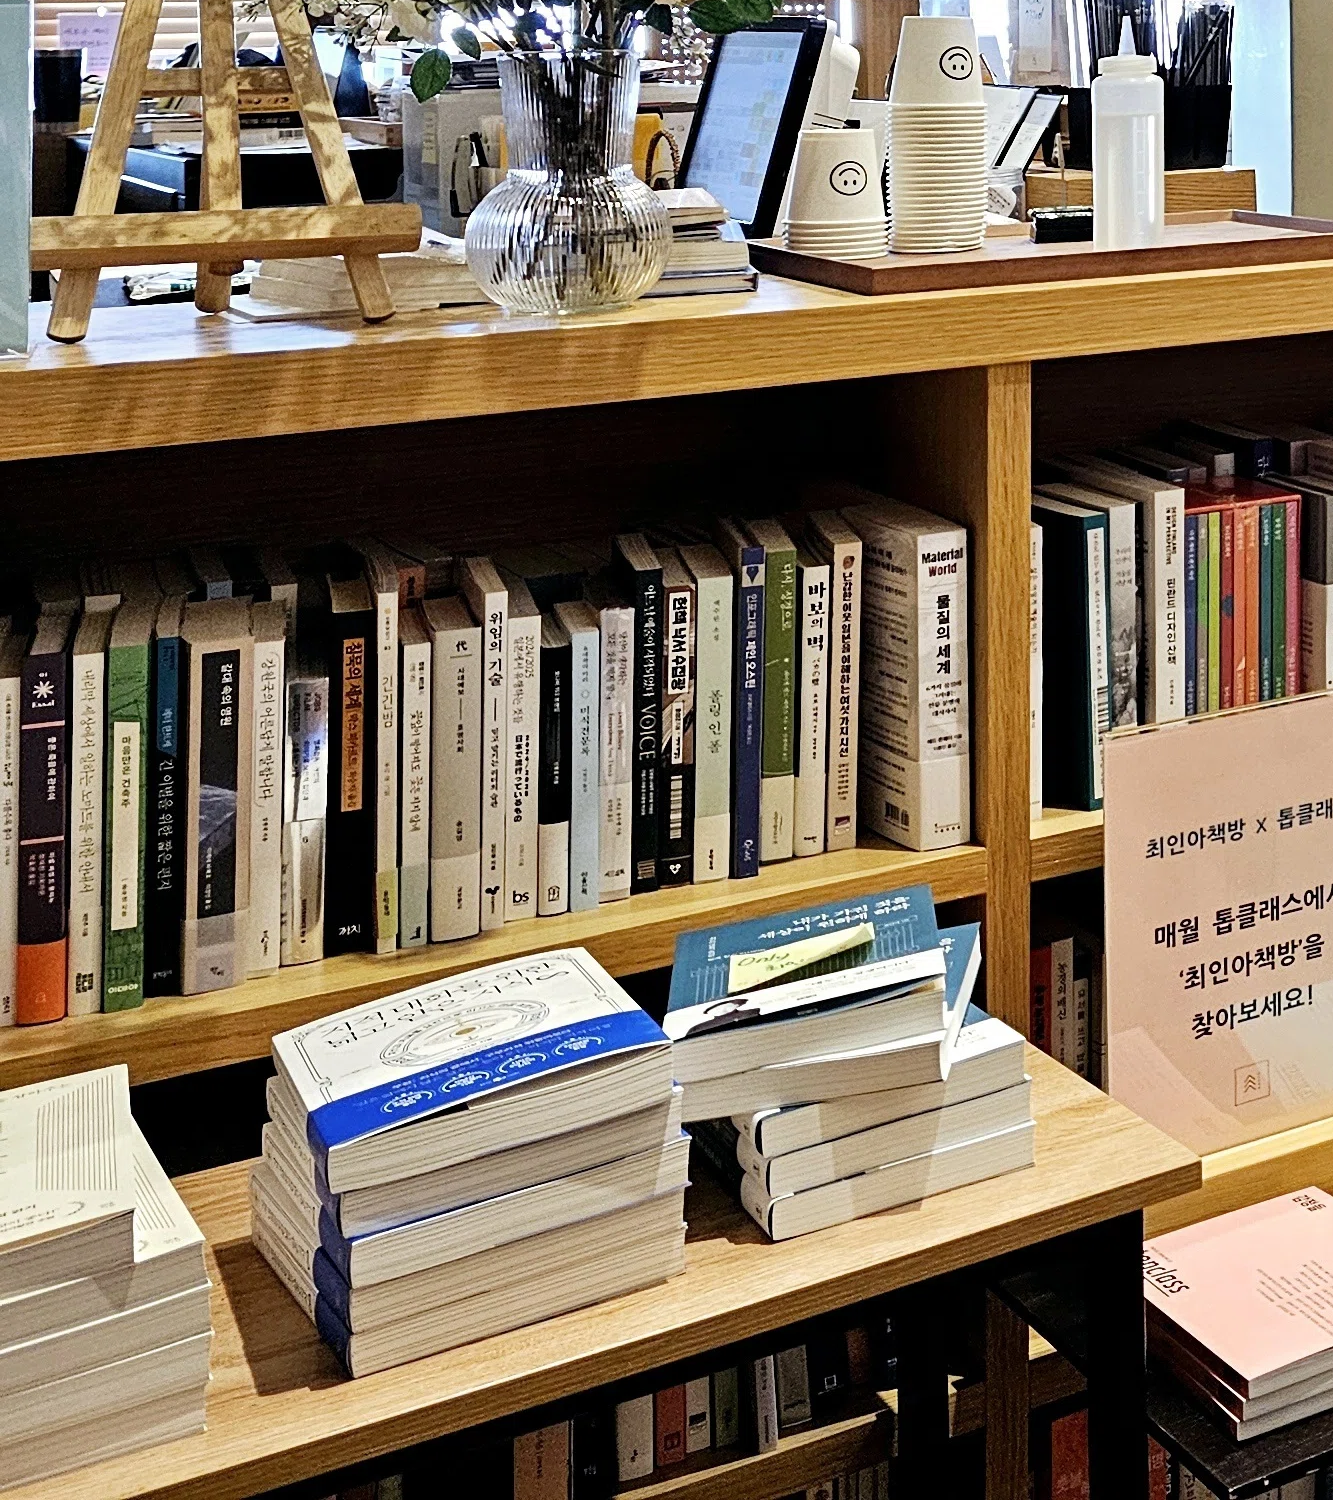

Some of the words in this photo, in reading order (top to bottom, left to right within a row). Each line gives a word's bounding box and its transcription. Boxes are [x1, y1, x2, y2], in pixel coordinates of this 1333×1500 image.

[922, 548, 963, 564] Material
[928, 564, 957, 575] World
[808, 582, 826, 628] 바보의
[1167, 578, 1176, 609] 핀란드
[672, 596, 687, 624] 헌책
[746, 593, 757, 638] 인포그래픽
[936, 595, 950, 640] 물질의
[489, 612, 502, 652] 위임의
[672, 628, 686, 652] 낙서
[1167, 612, 1176, 643] 디자인
[457, 641, 468, 652] 代
[513, 636, 523, 670] 일본에서
[525, 636, 535, 678] 2024/2025
[745, 640, 756, 660] 제인
[807, 636, 824, 651] 벽
[1167, 646, 1176, 665] 산책
[221, 663, 232, 683] 갈대
[345, 642, 361, 680] 침묵의
[489, 659, 502, 687] 기술
[671, 655, 686, 690] 수집광
[936, 644, 950, 674] 세계
[80, 669, 95, 702] 내리막
[261, 658, 275, 703] 강원국의
[513, 672, 524, 704] 유행하는
[745, 662, 755, 688] 오스틴
[220, 685, 233, 704] 속의
[345, 684, 361, 709] 세계
[382, 676, 392, 728] 긴긴밤
[80, 705, 95, 748] 세상에서
[220, 706, 232, 726] 영원
[260, 707, 274, 751] 어른답게
[513, 707, 524, 724] 것들
[639, 704, 656, 760] VOICE
[79, 752, 94, 786] 일하는
[159, 759, 174, 771] 긴
[259, 755, 273, 801] 말합니다
[78, 789, 94, 833] 노마드를
[158, 814, 173, 838] 위한
[78, 838, 94, 858] 위한
[157, 841, 173, 864] 짧은
[1145, 818, 1246, 861] 최인아책방
[78, 861, 94, 894] 안내서
[157, 868, 172, 891] 편지
[513, 891, 529, 903] bs
[757, 925, 810, 939] 세상이
[817, 912, 868, 928] 원하게
[793, 914, 829, 925] 내가
[833, 904, 868, 917] 가진
[338, 924, 361, 936] 까치
[1153, 918, 1204, 949] 매월
[737, 952, 789, 966] Only
[321, 1011, 384, 1038] 지적
[396, 978, 489, 1010] 대화를
[497, 962, 558, 981] 위한
[1191, 984, 1314, 1039] 찾아보세요!
[1143, 1250, 1190, 1295] opclass
